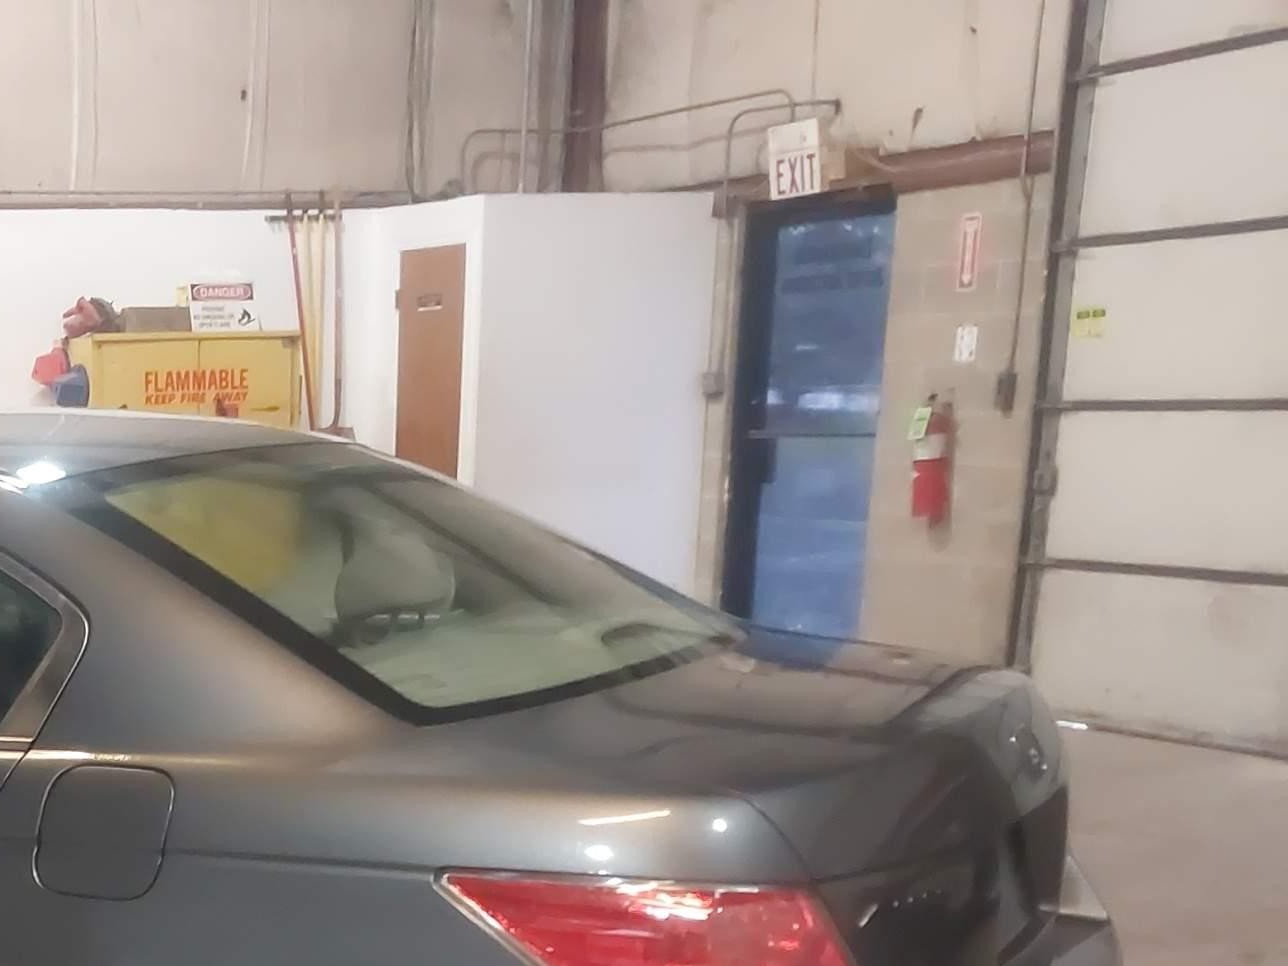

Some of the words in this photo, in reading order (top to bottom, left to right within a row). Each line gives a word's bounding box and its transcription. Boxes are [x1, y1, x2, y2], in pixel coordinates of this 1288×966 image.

[776, 152, 816, 195] EXIT
[200, 287, 244, 297] DANGER
[145, 369, 248, 392] FLAMMABLE
[145, 393, 176, 405] KEEP
[180, 392, 207, 404] FIRE
[213, 391, 249, 402] AWAY
